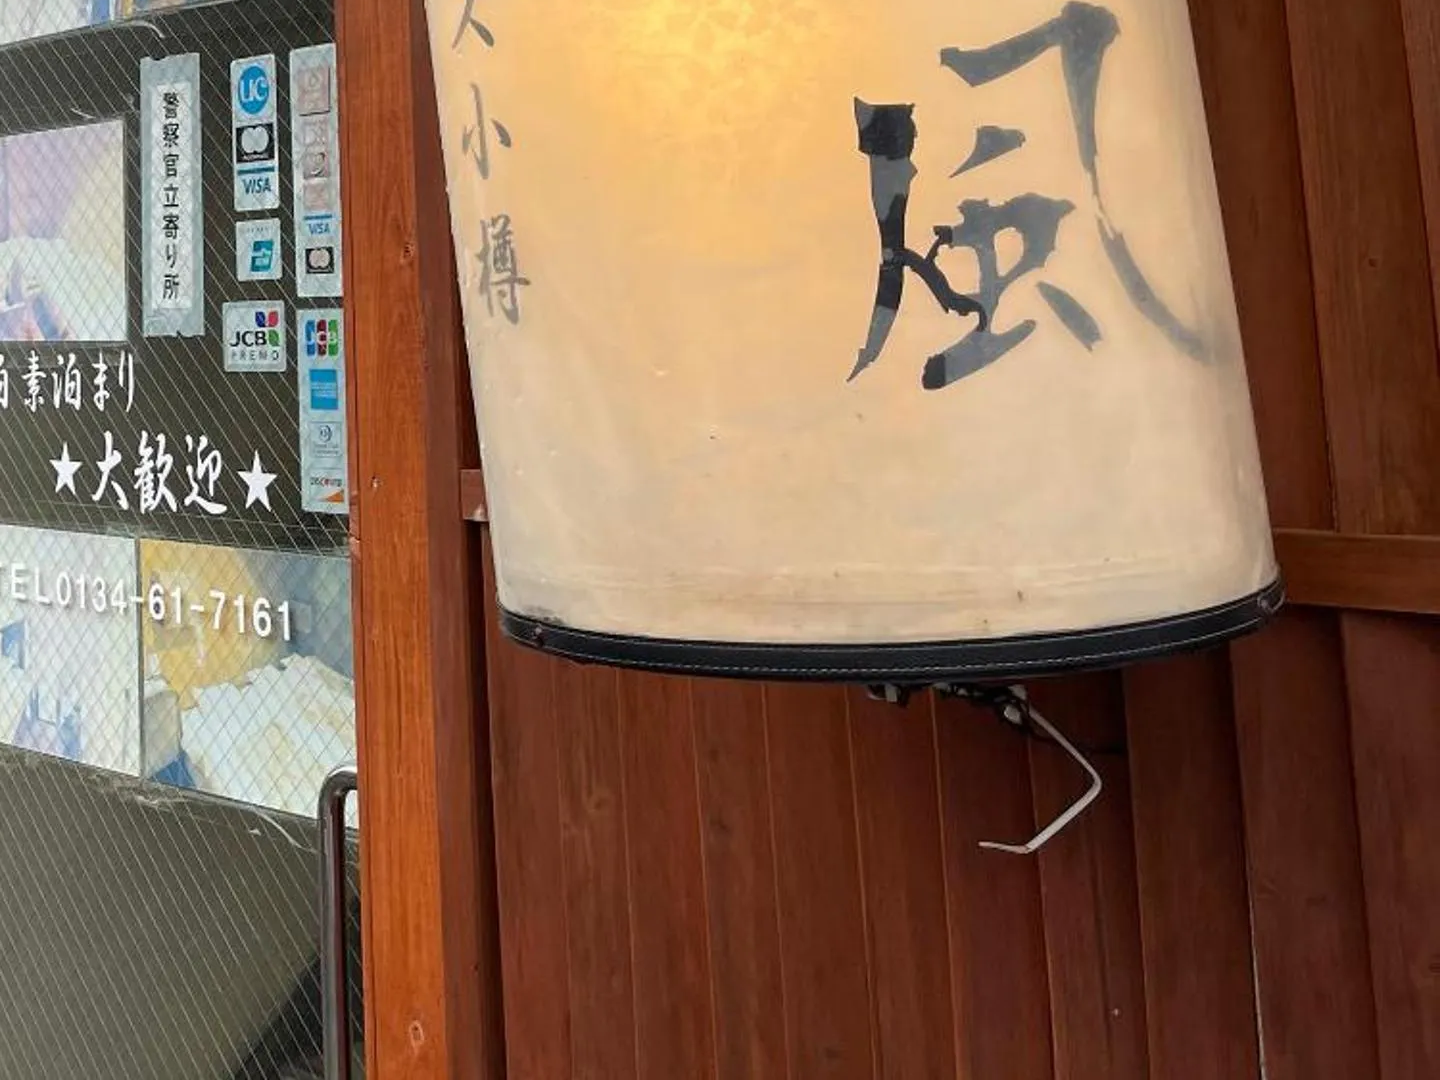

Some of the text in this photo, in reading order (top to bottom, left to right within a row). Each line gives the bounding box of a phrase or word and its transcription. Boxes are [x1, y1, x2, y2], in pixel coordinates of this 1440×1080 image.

[240, 78, 268, 103] UC
[162, 91, 180, 300] 警察官立寄り所
[242, 177, 272, 195] VISA
[308, 223, 331, 236] VISA
[229, 330, 268, 348] JCB
[91, 430, 228, 514] 大歓迎
